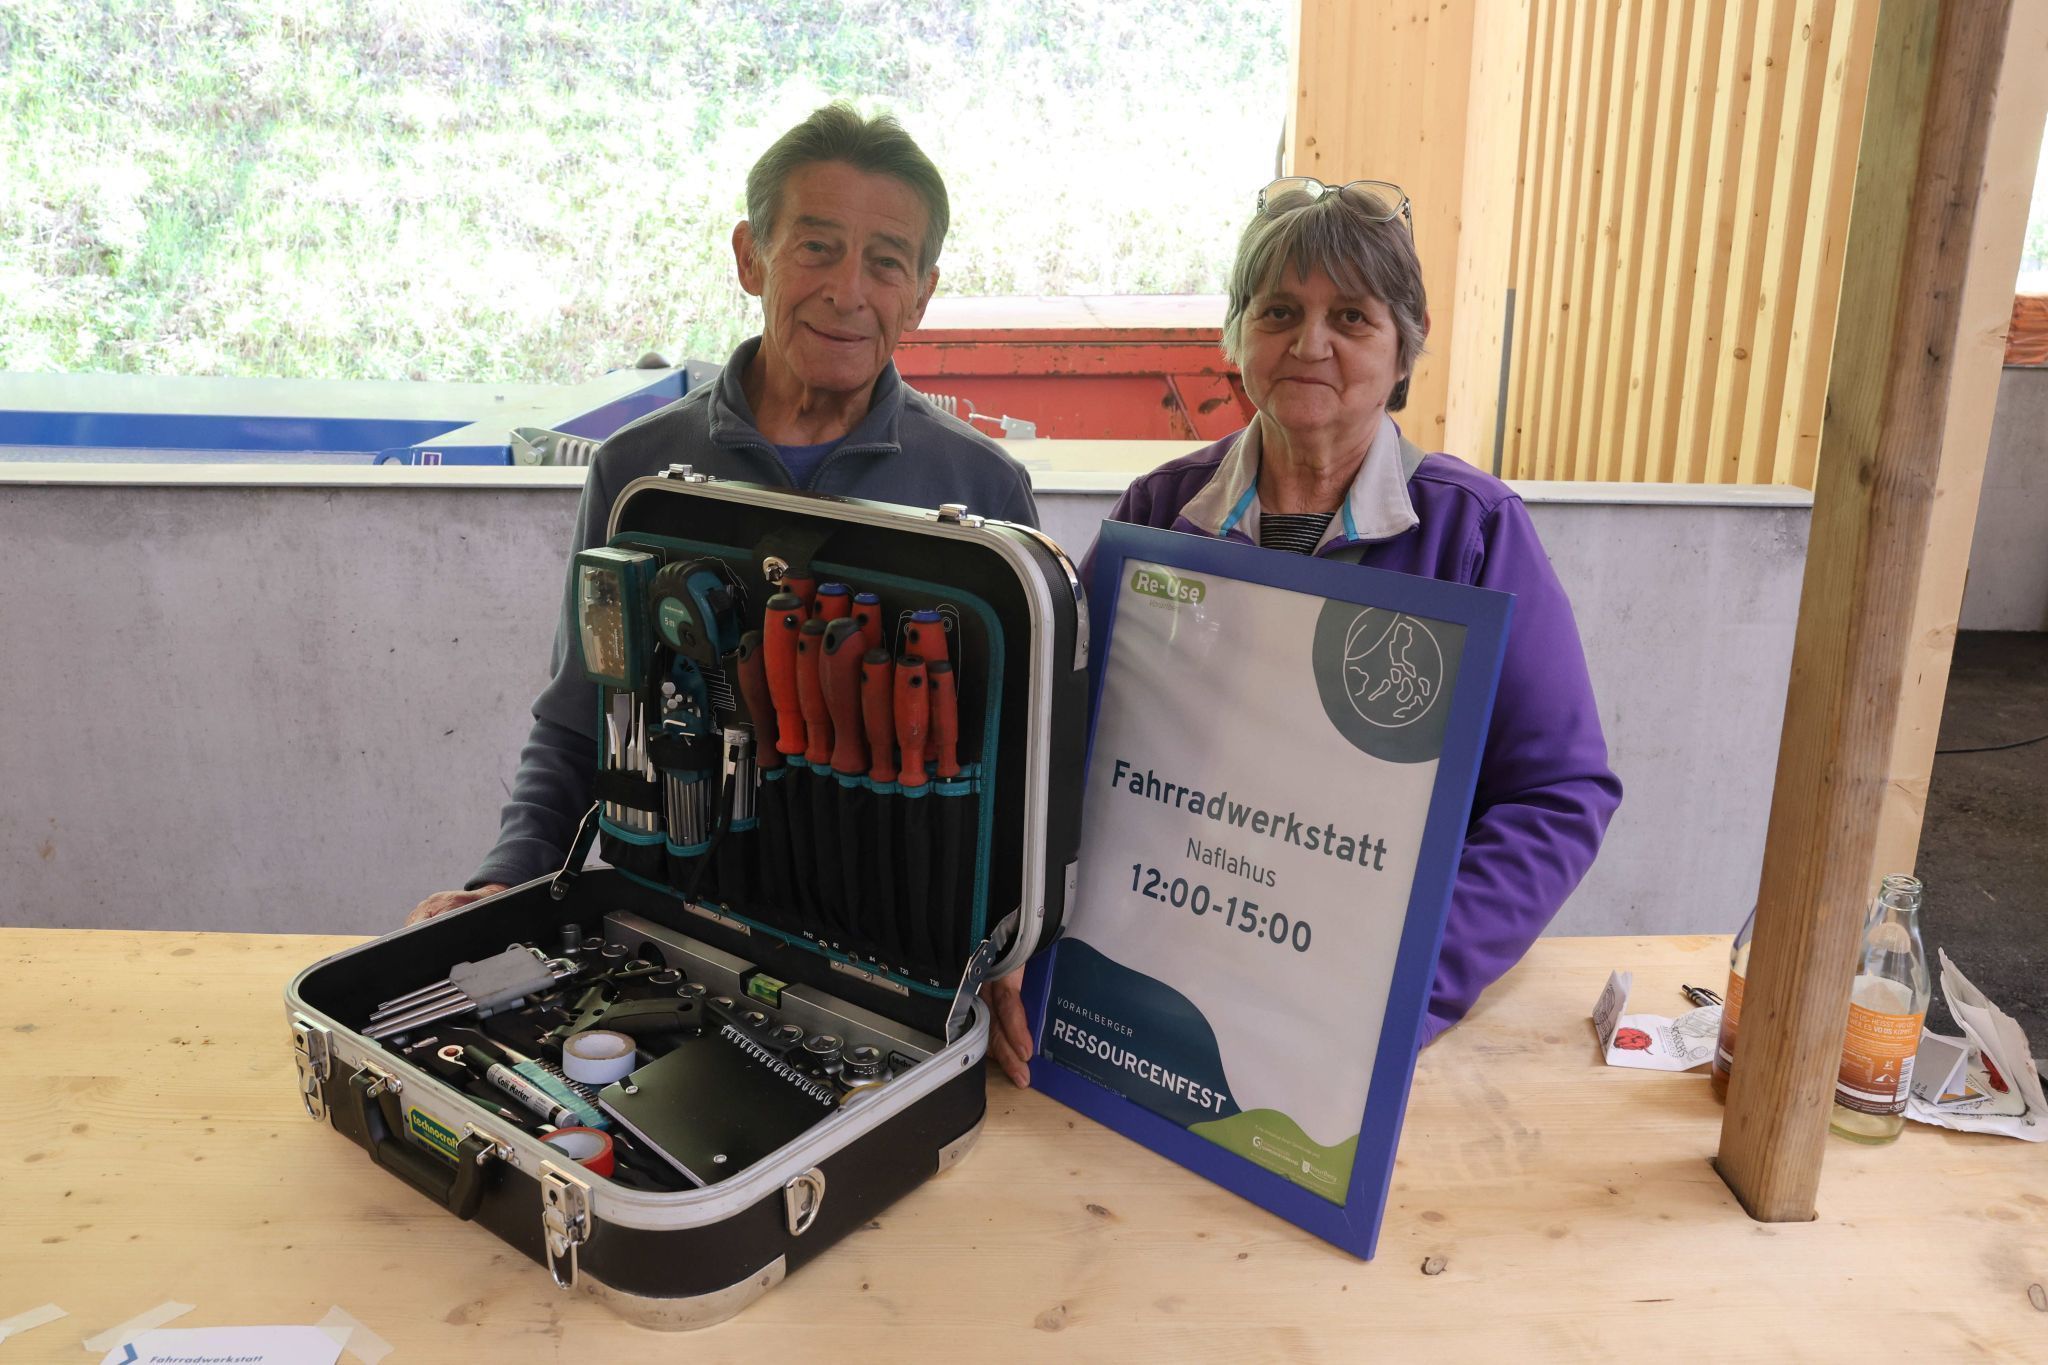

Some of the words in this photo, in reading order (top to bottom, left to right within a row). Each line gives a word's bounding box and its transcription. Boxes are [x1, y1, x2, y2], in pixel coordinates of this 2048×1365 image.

[1136, 572, 1200, 602] Re-Use
[1112, 759, 1387, 871] Fahrradwerkstatt
[1186, 838, 1276, 887] Naflahus
[1132, 863, 1312, 952] 12:00-15:00
[1057, 996, 1134, 1038] VORARLBERGER
[1053, 1018, 1227, 1113] RESSOURCENFEST
[509, 1084, 530, 1102] Marker
[149, 1355, 263, 1364] Fahrradwerkstatt
